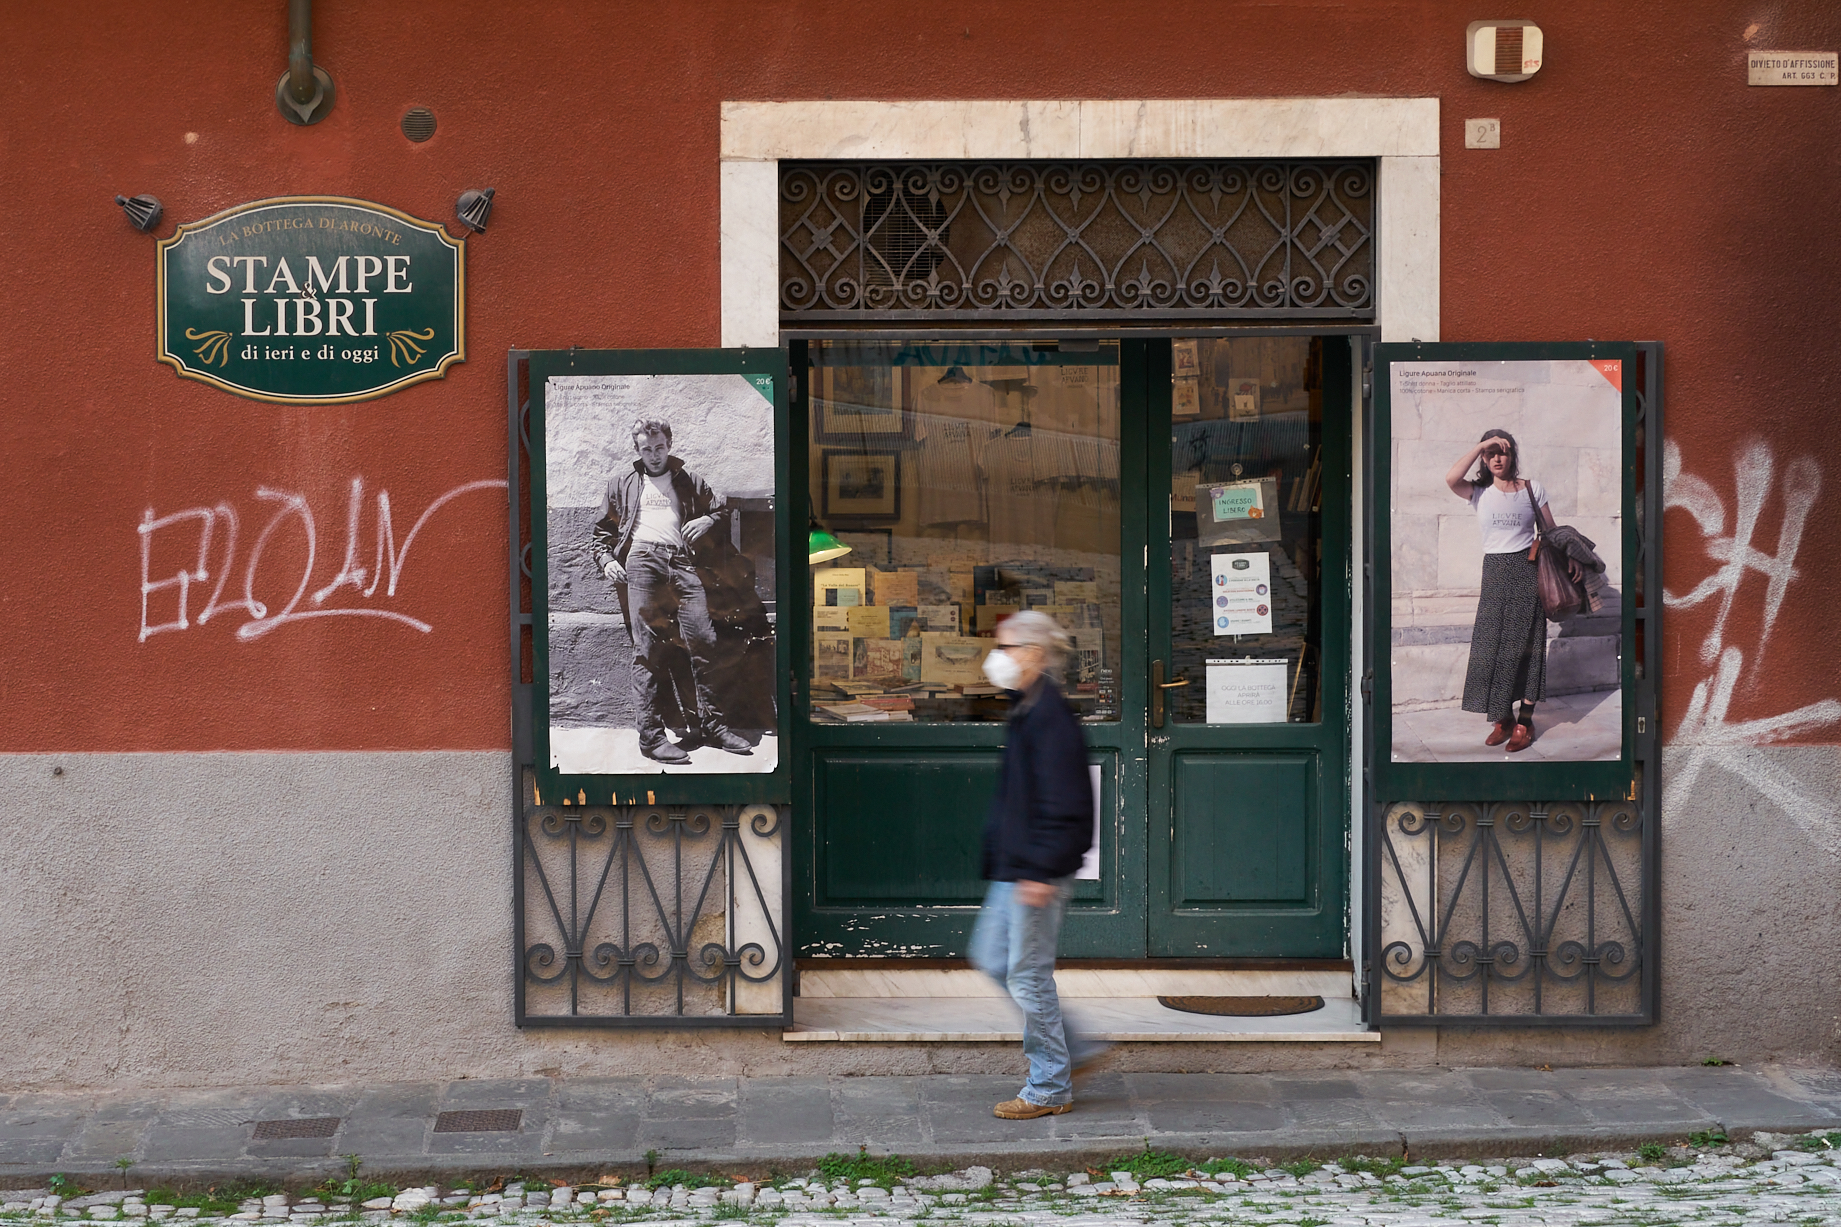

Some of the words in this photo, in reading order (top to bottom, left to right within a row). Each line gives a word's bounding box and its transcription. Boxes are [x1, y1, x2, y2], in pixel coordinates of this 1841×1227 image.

[1750, 60, 1781, 68] DIVIETO
[1782, 59, 1836, 68] D'AFFISSIONE
[218, 231, 240, 247] LA
[242, 217, 314, 237] BOTTEGA
[319, 217, 335, 229] DI
[339, 217, 402, 246] ARONTE
[206, 255, 412, 294] STAMPE
[300, 280, 318, 301] &
[240, 297, 379, 337] LIBRI
[241, 344, 258, 360] di
[264, 345, 295, 360] ieri
[301, 349, 311, 360] e
[317, 344, 335, 360] di
[341, 345, 379, 364] oggi
[1604, 364, 1612, 372] 20
[1613, 364, 1619, 372] €
[554, 383, 575, 391] Ligure
[601, 383, 631, 391] Originale
[1218, 497, 1252, 506] INGRESSO
[1223, 506, 1246, 514] LIBERO
